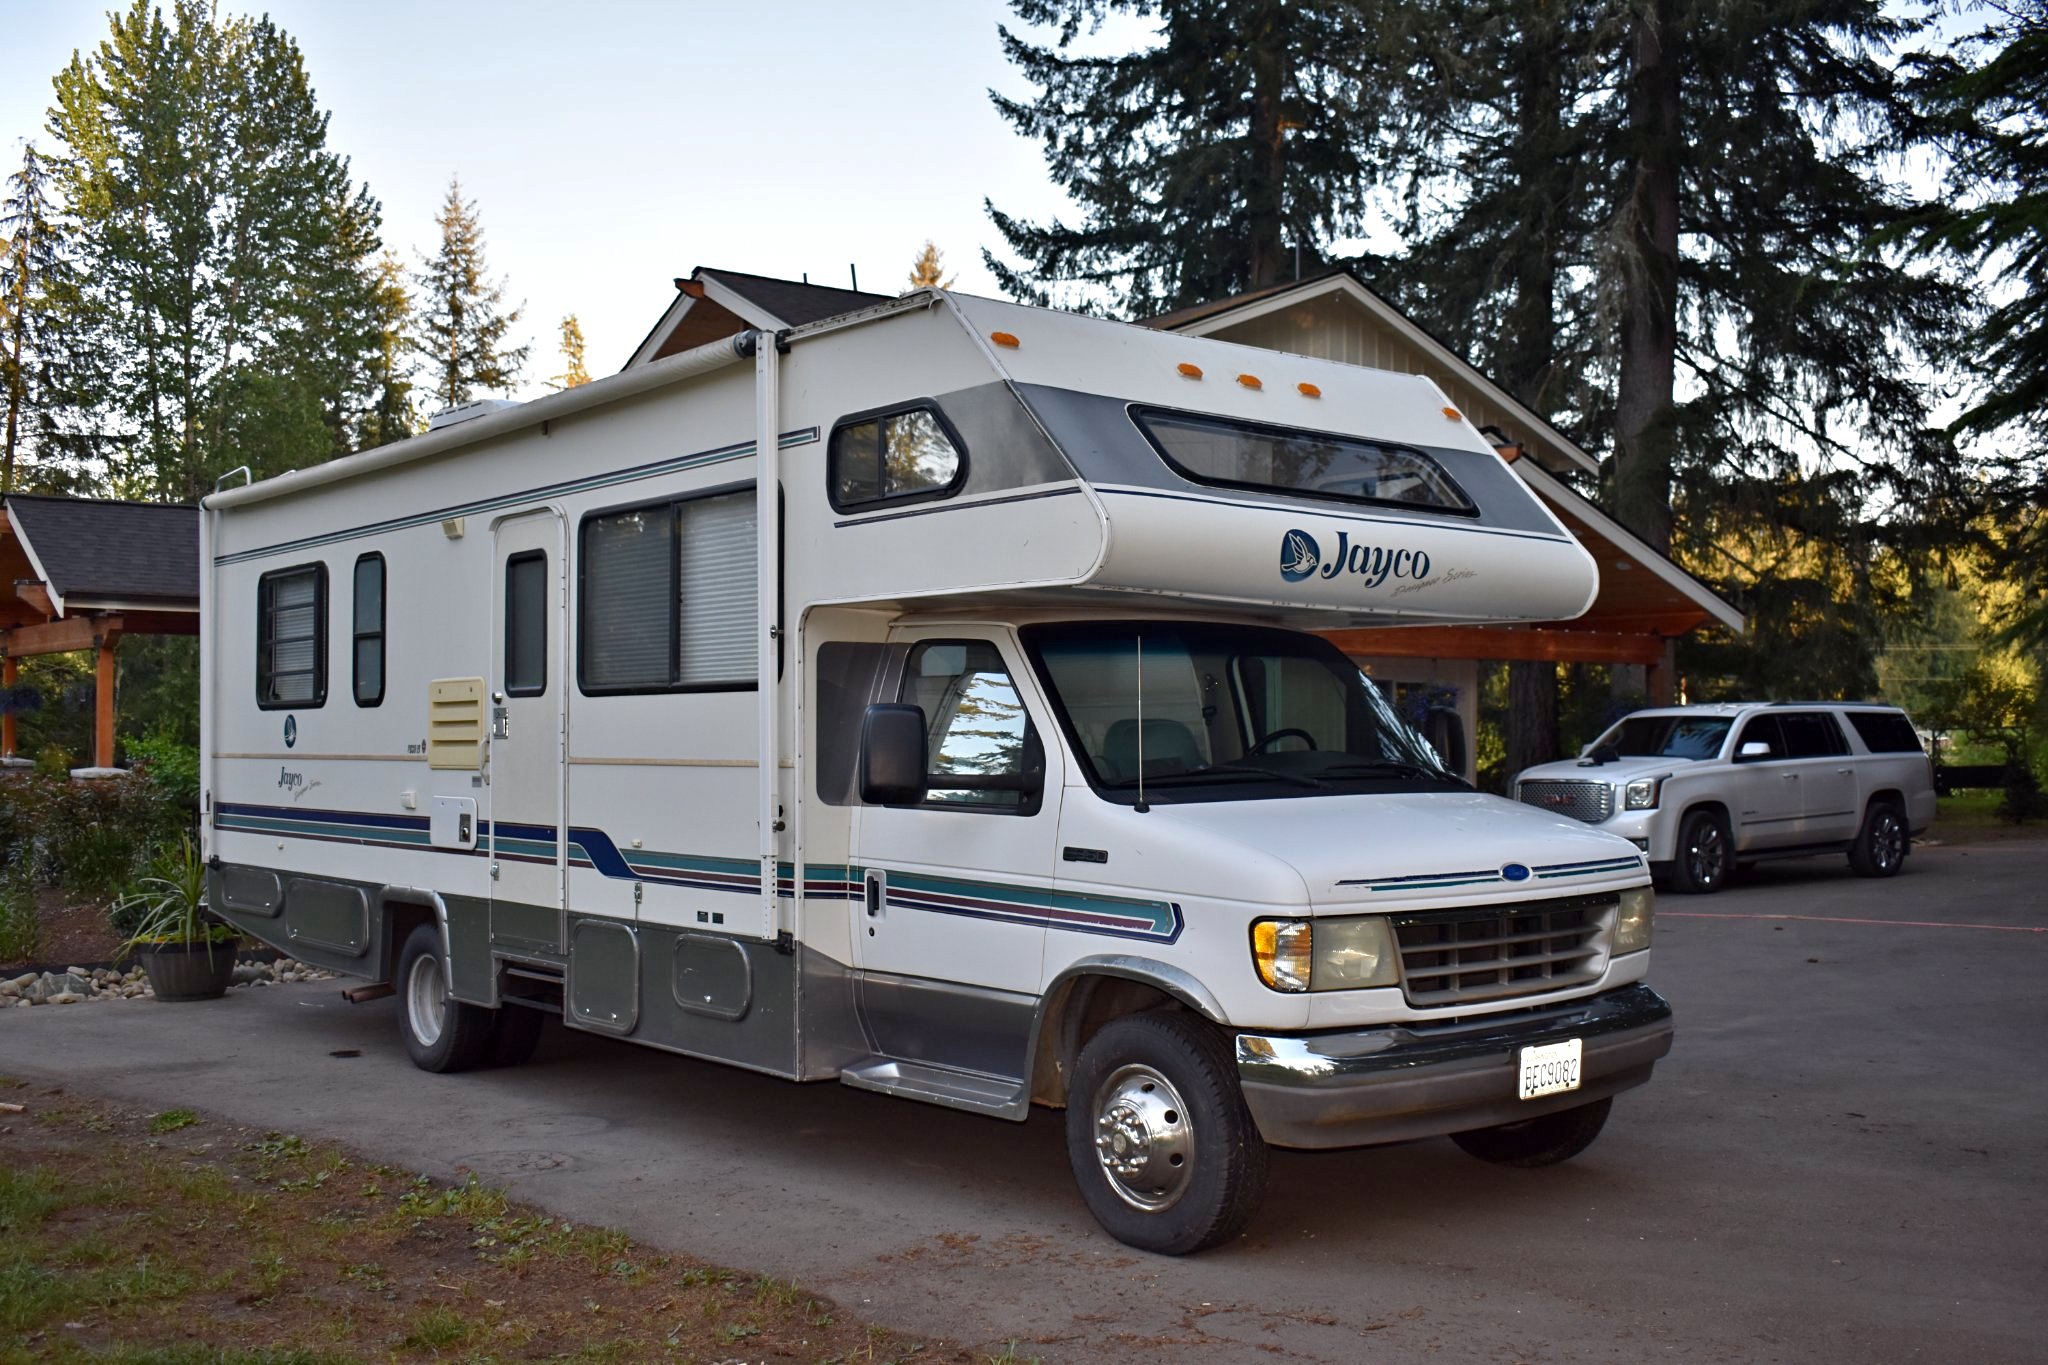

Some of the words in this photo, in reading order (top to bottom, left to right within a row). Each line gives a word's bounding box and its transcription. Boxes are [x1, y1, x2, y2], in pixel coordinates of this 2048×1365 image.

[1321, 531, 1430, 588] Jayco
[278, 766, 303, 791] Jayco
[1525, 1058, 1578, 1091] BEC9082
